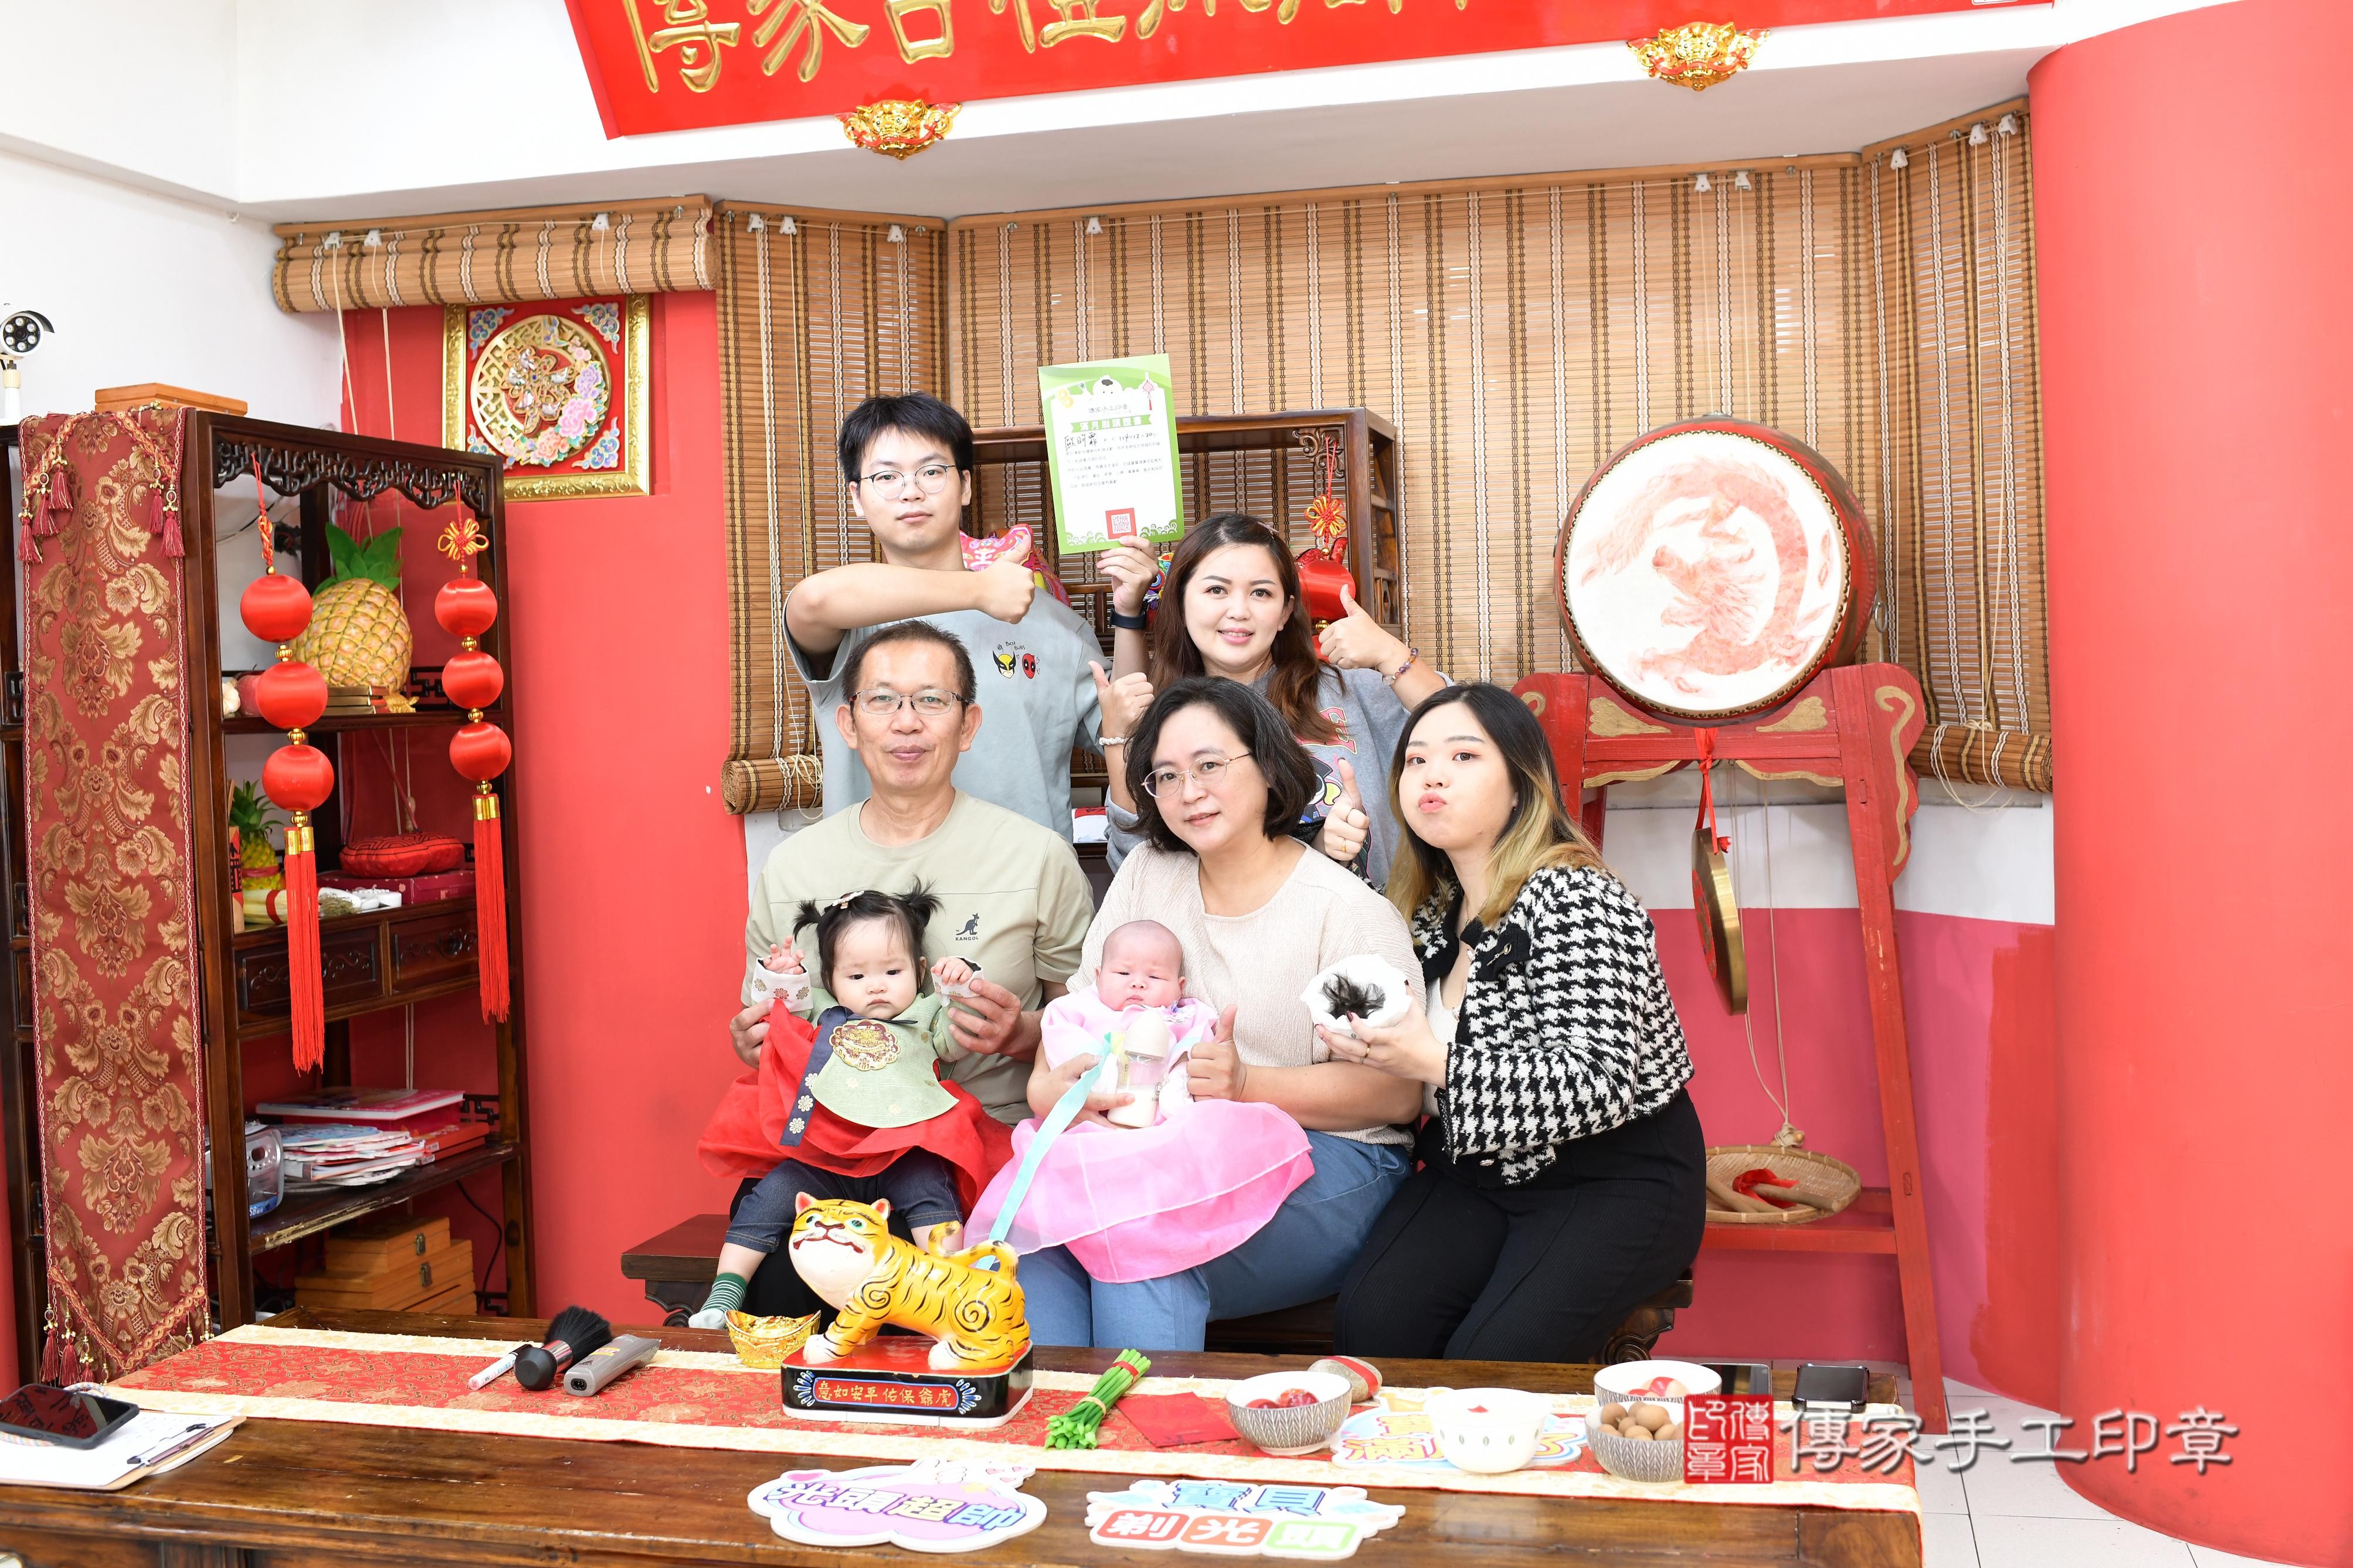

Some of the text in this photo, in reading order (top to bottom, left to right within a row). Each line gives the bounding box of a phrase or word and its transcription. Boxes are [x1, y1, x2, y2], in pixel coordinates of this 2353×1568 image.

[763, 1482, 1027, 1530] 光頭超帥
[1162, 1483, 1326, 1516] 寶貝
[1106, 1512, 1348, 1549] 剃光頭
